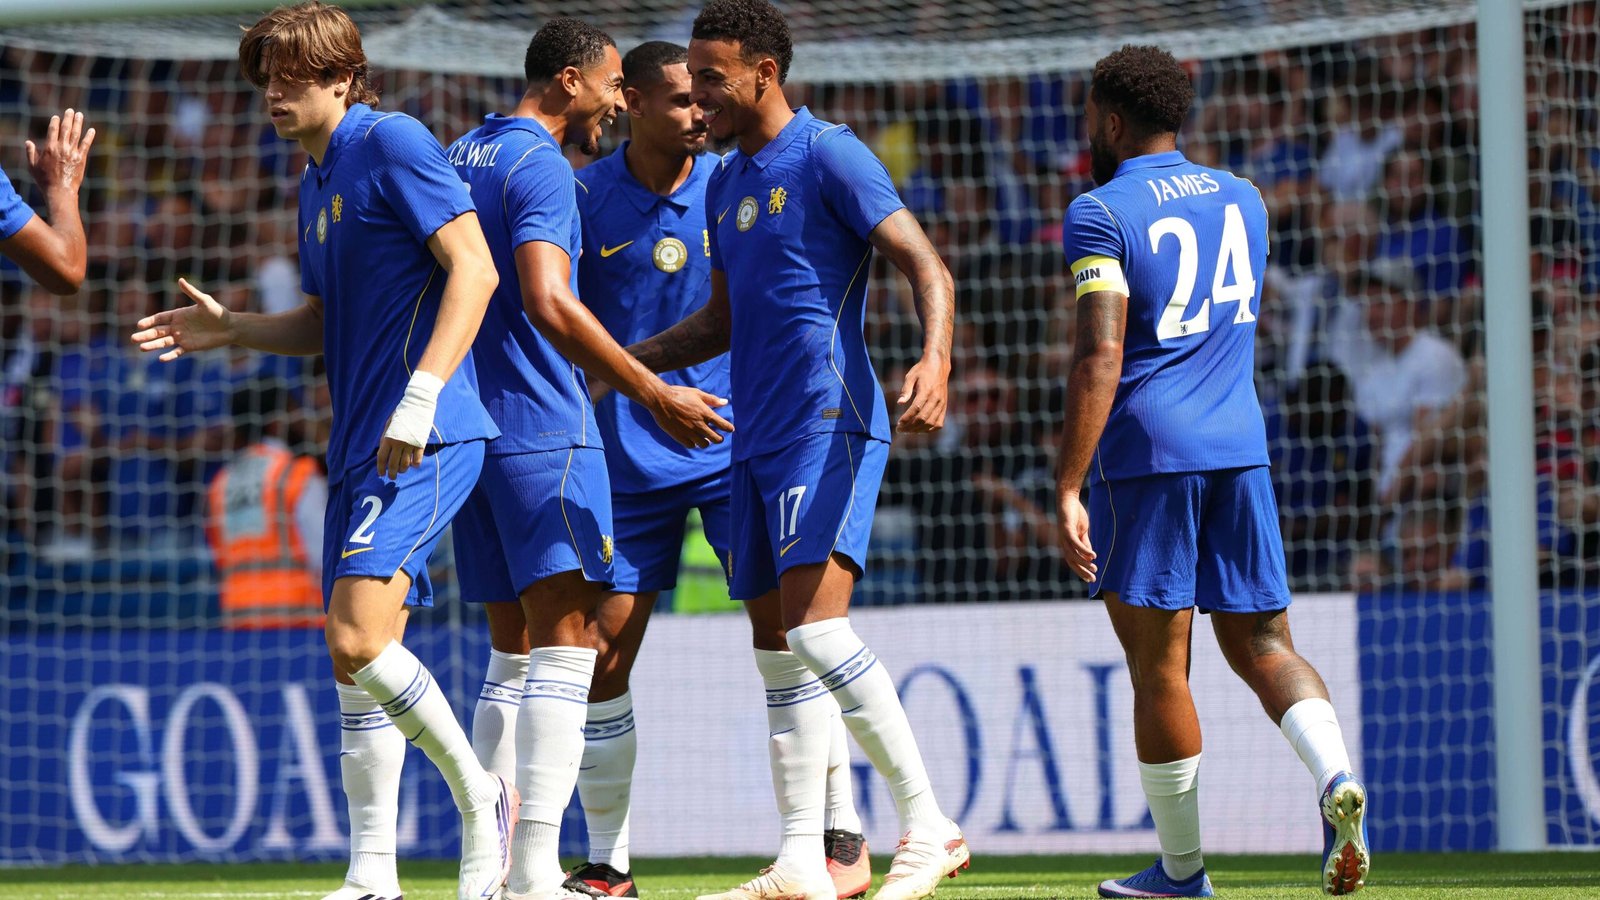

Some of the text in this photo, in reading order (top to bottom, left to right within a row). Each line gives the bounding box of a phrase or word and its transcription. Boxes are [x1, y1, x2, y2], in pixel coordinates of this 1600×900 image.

[1146, 172, 1220, 207] JAMES
[1148, 203, 1256, 341] 24
[349, 495, 383, 545] 2
[778, 485, 807, 542] 17
[68, 681, 419, 852] GOA
[851, 661, 1156, 833] OAL
